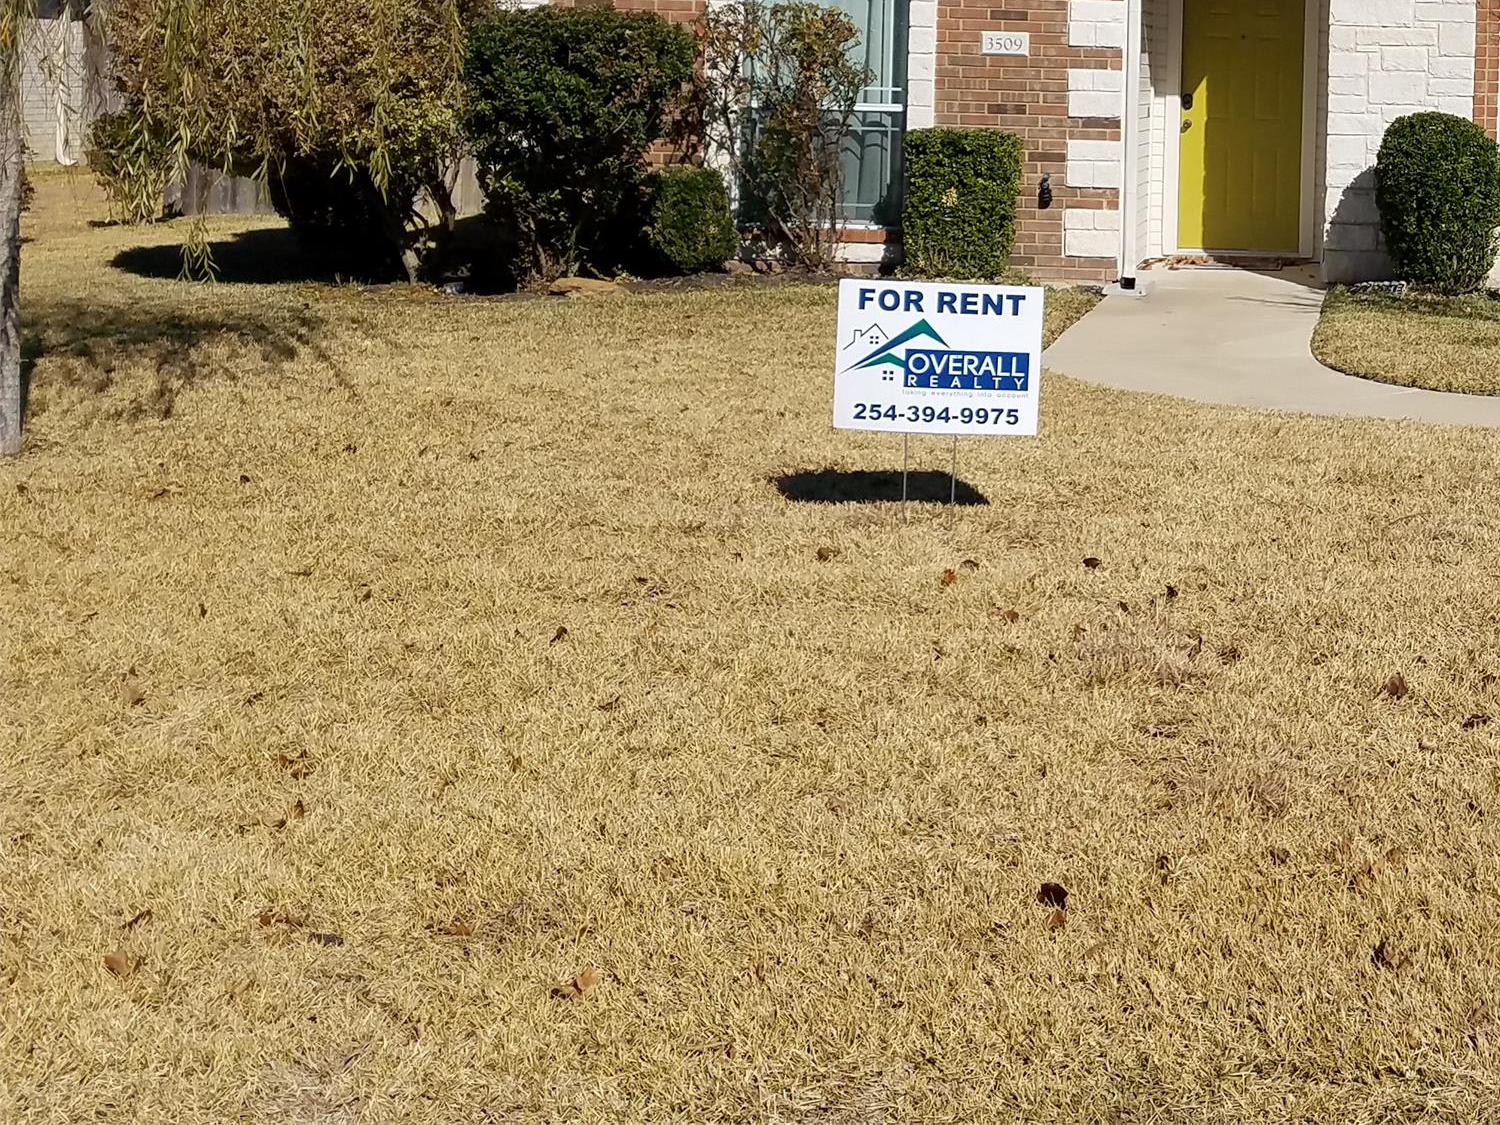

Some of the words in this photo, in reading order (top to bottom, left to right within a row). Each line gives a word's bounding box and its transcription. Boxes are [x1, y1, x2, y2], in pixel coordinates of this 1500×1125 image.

[986, 37, 1022, 51] 3509
[858, 288, 924, 312] FOR
[937, 291, 1026, 316] RENT
[908, 353, 1025, 377] OVERALL
[907, 375, 1025, 390] REALTY
[931, 390, 973, 399] everything
[853, 403, 1019, 425] 254-394-9975
